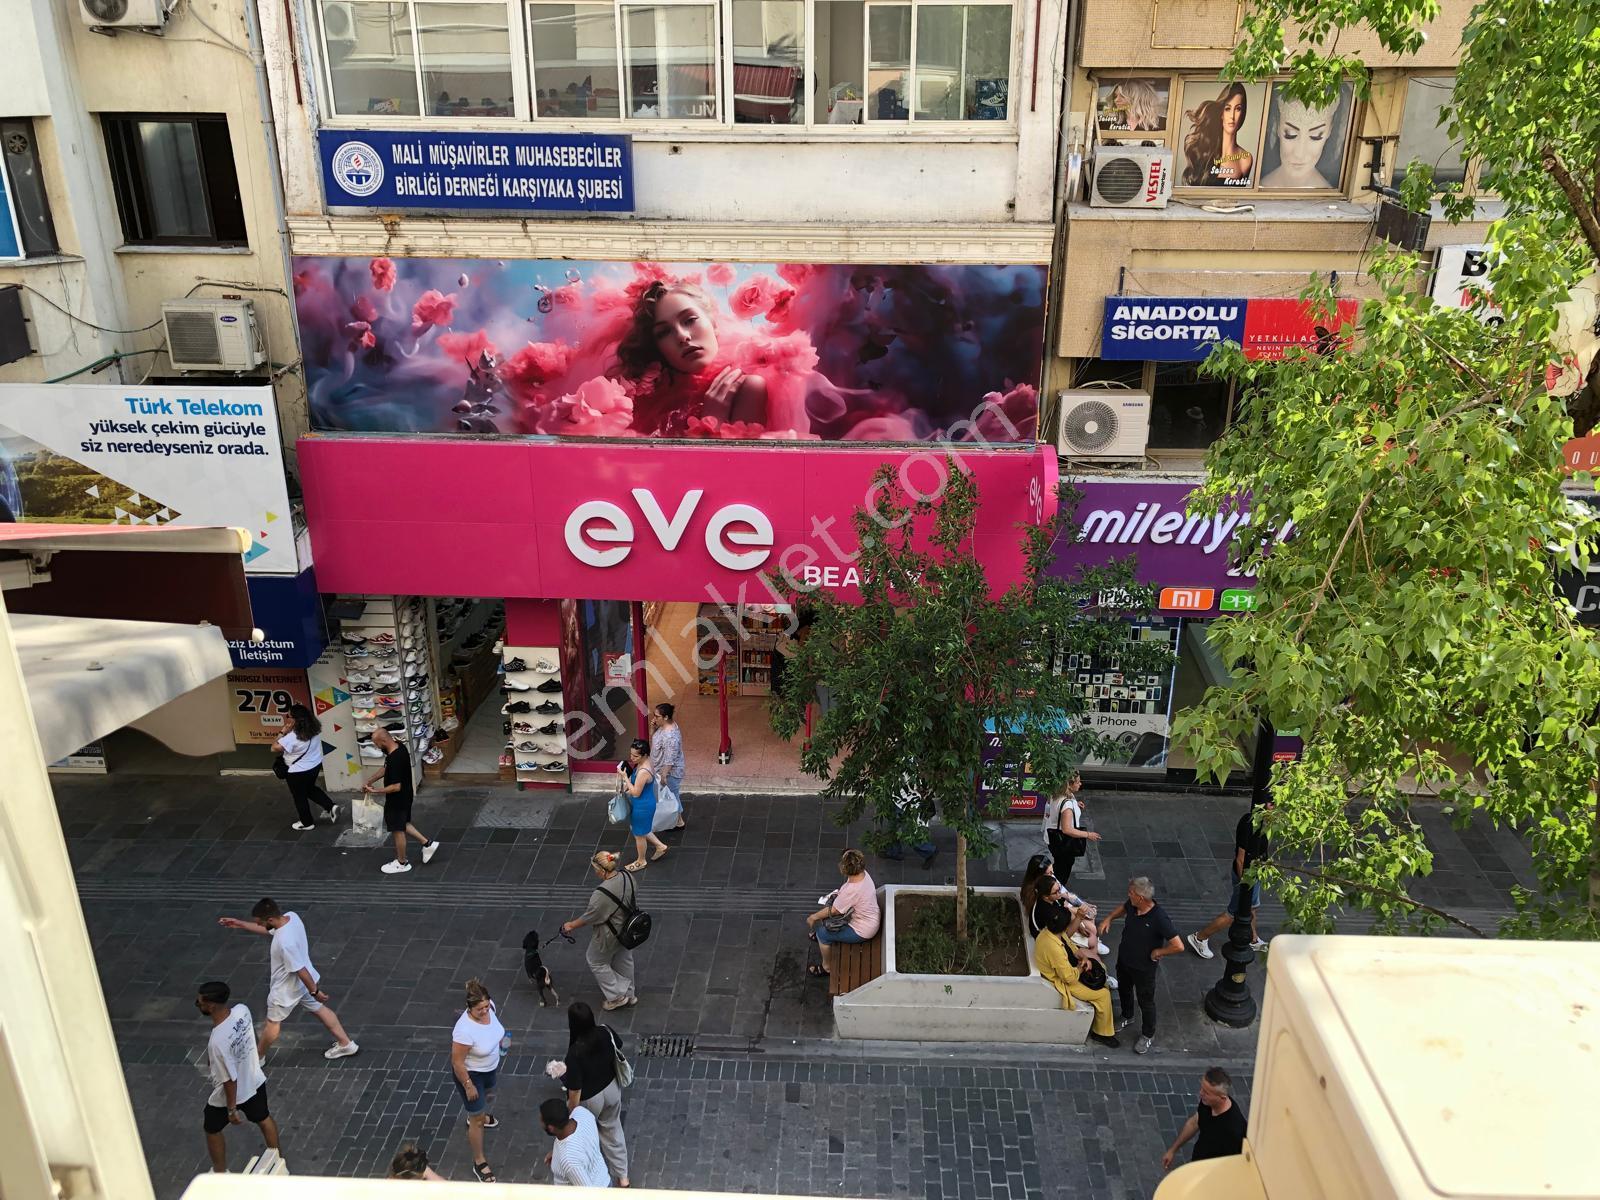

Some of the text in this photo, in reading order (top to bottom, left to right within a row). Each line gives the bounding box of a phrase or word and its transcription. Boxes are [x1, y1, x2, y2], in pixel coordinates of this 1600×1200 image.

[392, 141, 622, 170] MALİ MÜŞAVİRLER MUHASEBECİLER
[395, 172, 623, 204] BİRLİĞİ DERNEĞİ KARŞIYAKA ŞUBESİ
[1146, 159, 1162, 203] VESTEL
[1113, 305, 1239, 321] ANADOLU
[1111, 321, 1222, 340] SİGORTA
[1249, 333, 1296, 342] YETKİLİ
[125, 397, 263, 416] Türk Telekom
[89, 420, 266, 439] yüksek çekim gücüyle
[80, 439, 269, 456] siz neredeyseniz orada.
[564, 488, 774, 571] eve
[239, 648, 283, 662] İletişim
[236, 688, 292, 713] 279
[1096, 716, 1137, 726] iPhone
